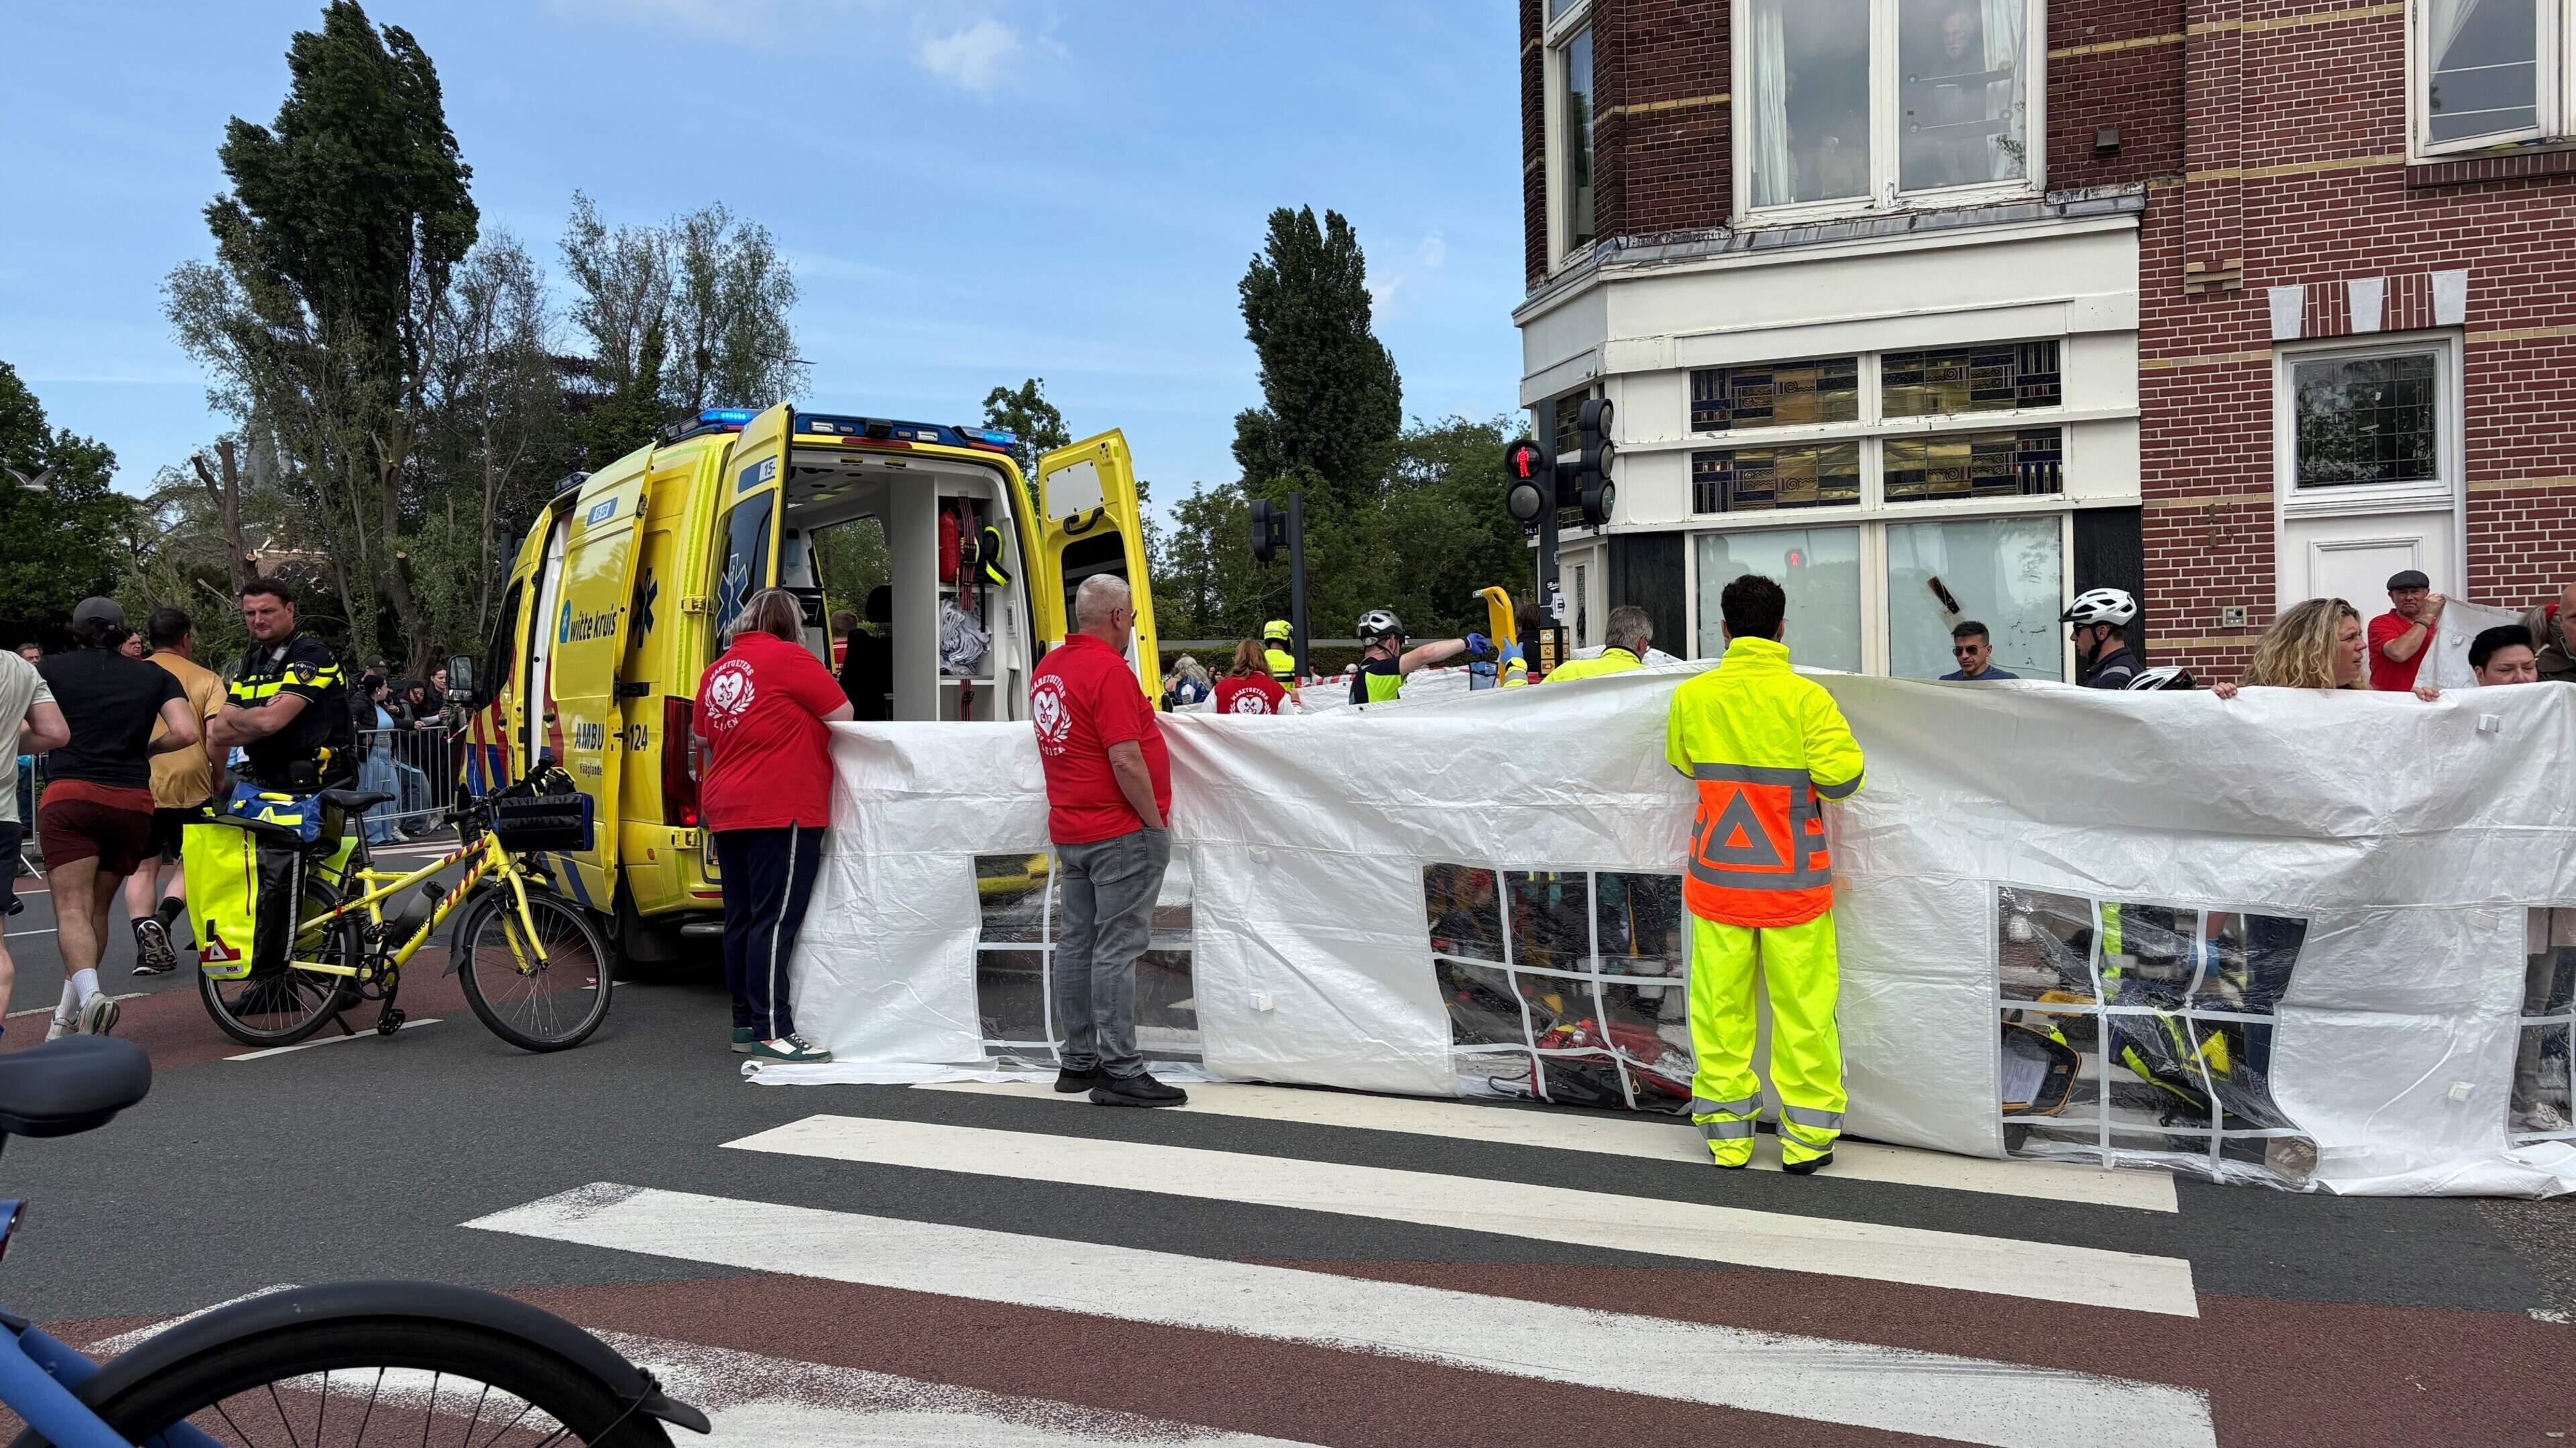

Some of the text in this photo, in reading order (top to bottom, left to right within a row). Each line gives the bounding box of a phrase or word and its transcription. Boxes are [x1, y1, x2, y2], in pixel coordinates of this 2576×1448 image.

[570, 602, 617, 643] witte kruis
[575, 723, 604, 751] AMBU
